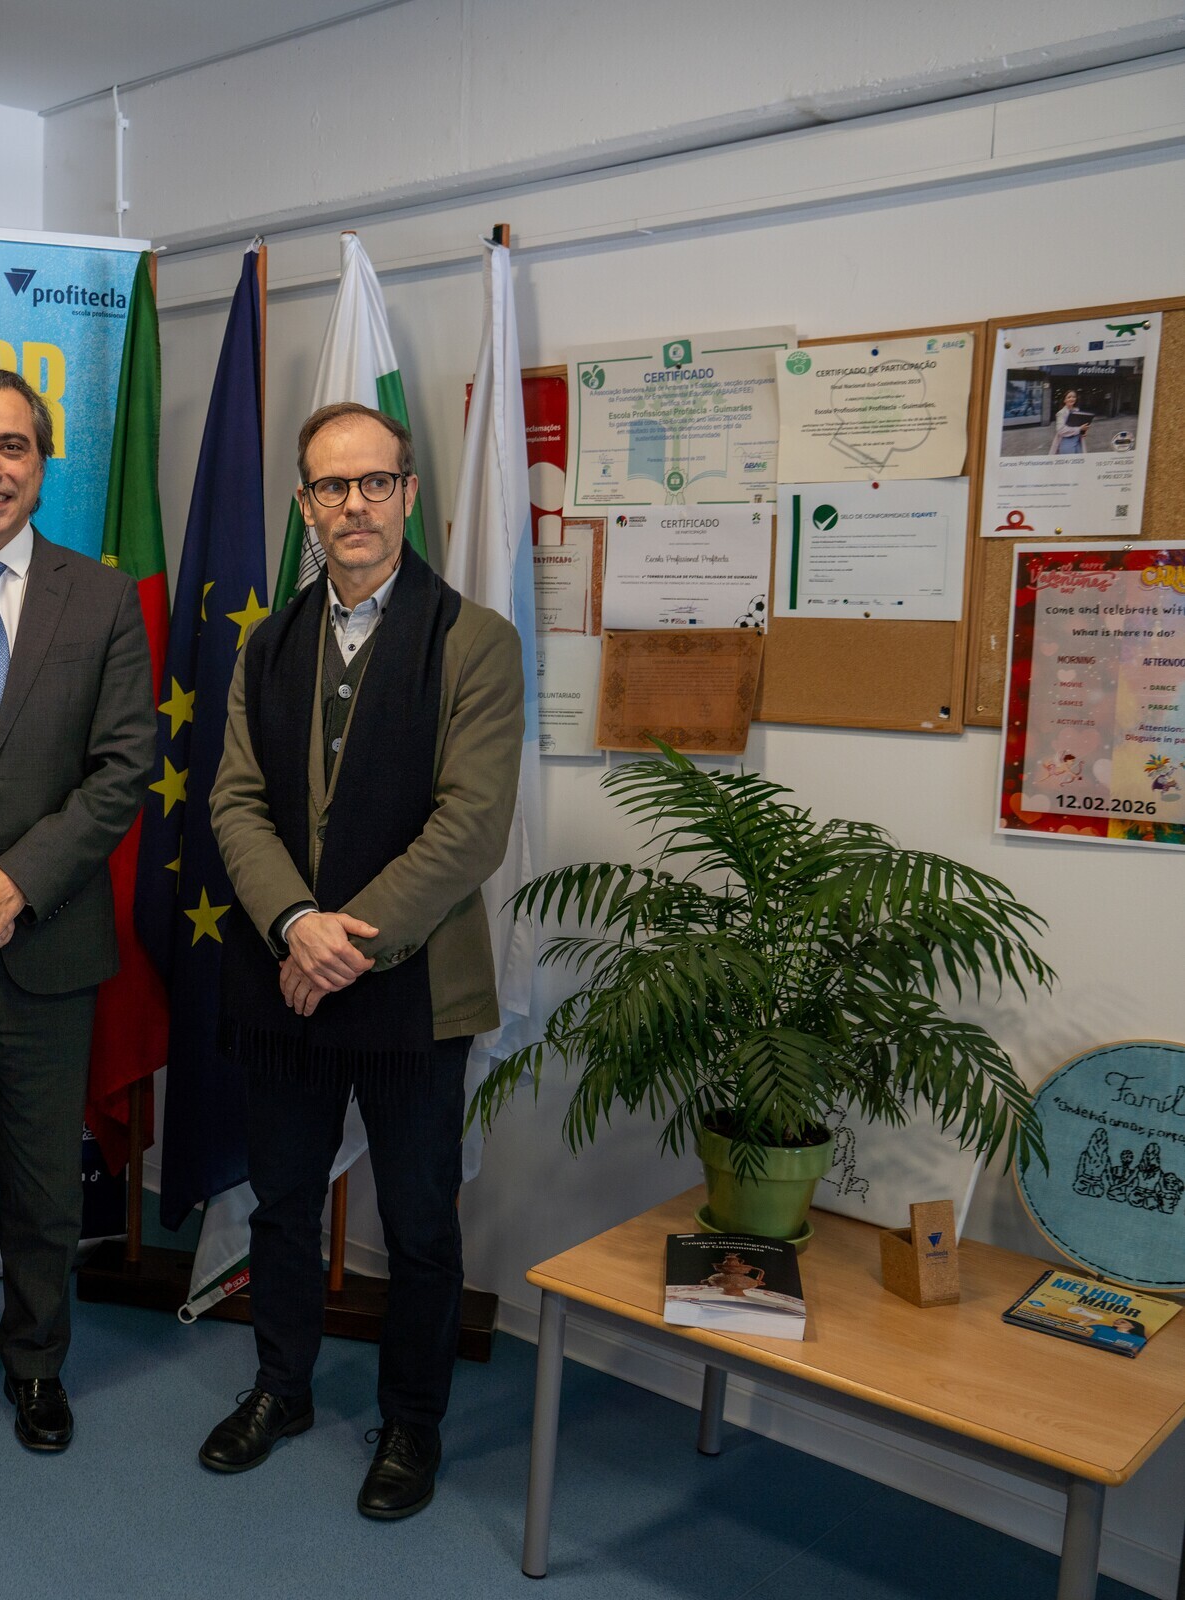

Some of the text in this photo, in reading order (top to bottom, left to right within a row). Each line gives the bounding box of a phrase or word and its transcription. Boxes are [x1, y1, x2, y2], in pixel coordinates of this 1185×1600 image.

[33, 285, 126, 308] profitecla
[92, 311, 126, 319] profissional
[816, 360, 936, 378] CERTIFICADO DE PARTICIPAÇÃO
[1078, 366, 1116, 376] profitecla
[644, 368, 714, 383] CERTIFICADO
[608, 412, 630, 420] Escola
[632, 409, 672, 418] Profissional
[714, 404, 752, 413] Guimarães
[660, 518, 720, 528] CERTIFICADO
[645, 554, 730, 565] Escola Profissional Profitecla
[1078, 604, 1100, 615] and
[1103, 604, 1158, 616] celebrate
[1162, 604, 1185, 616] wit
[1072, 628, 1175, 638] What is there to do?
[1057, 656, 1096, 665] MORNING
[1056, 718, 1095, 726] ACTIVITIES
[1138, 724, 1184, 732] Attention:
[1125, 734, 1162, 744] Disguise
[1056, 794, 1156, 815] 12.02.2026
[712, 1244, 764, 1252] Gastronomia
[718, 1240, 783, 1252] Historiográficas
[1051, 1278, 1133, 1307] MELHOR
[1077, 1295, 1142, 1318] MAIOR
